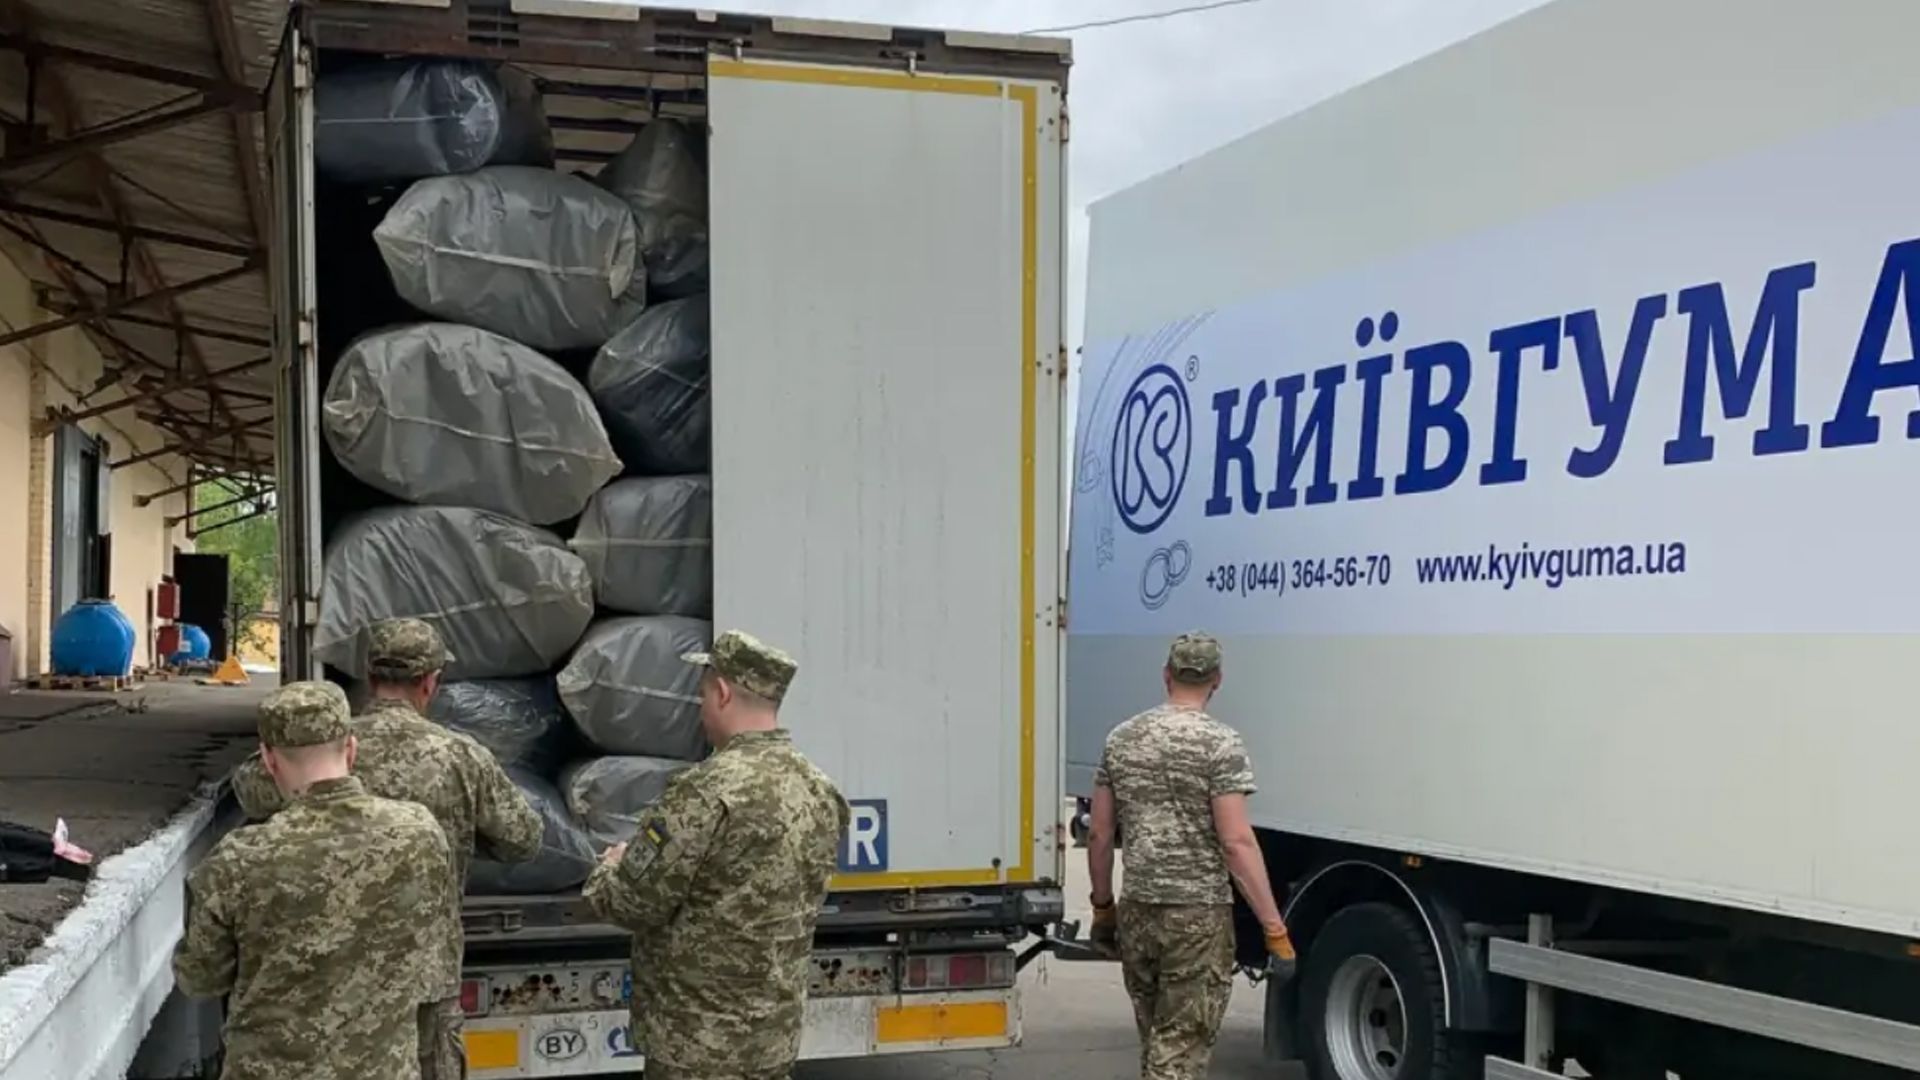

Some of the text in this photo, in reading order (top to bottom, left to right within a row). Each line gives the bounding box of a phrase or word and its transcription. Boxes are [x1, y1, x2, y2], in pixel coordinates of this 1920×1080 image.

[1204, 238, 1920, 517] КИЇВГУМА
[1206, 541, 1686, 598] +38 (044) 364-56-70 www.kyivguma.ua
[546, 1034, 578, 1055] BY
